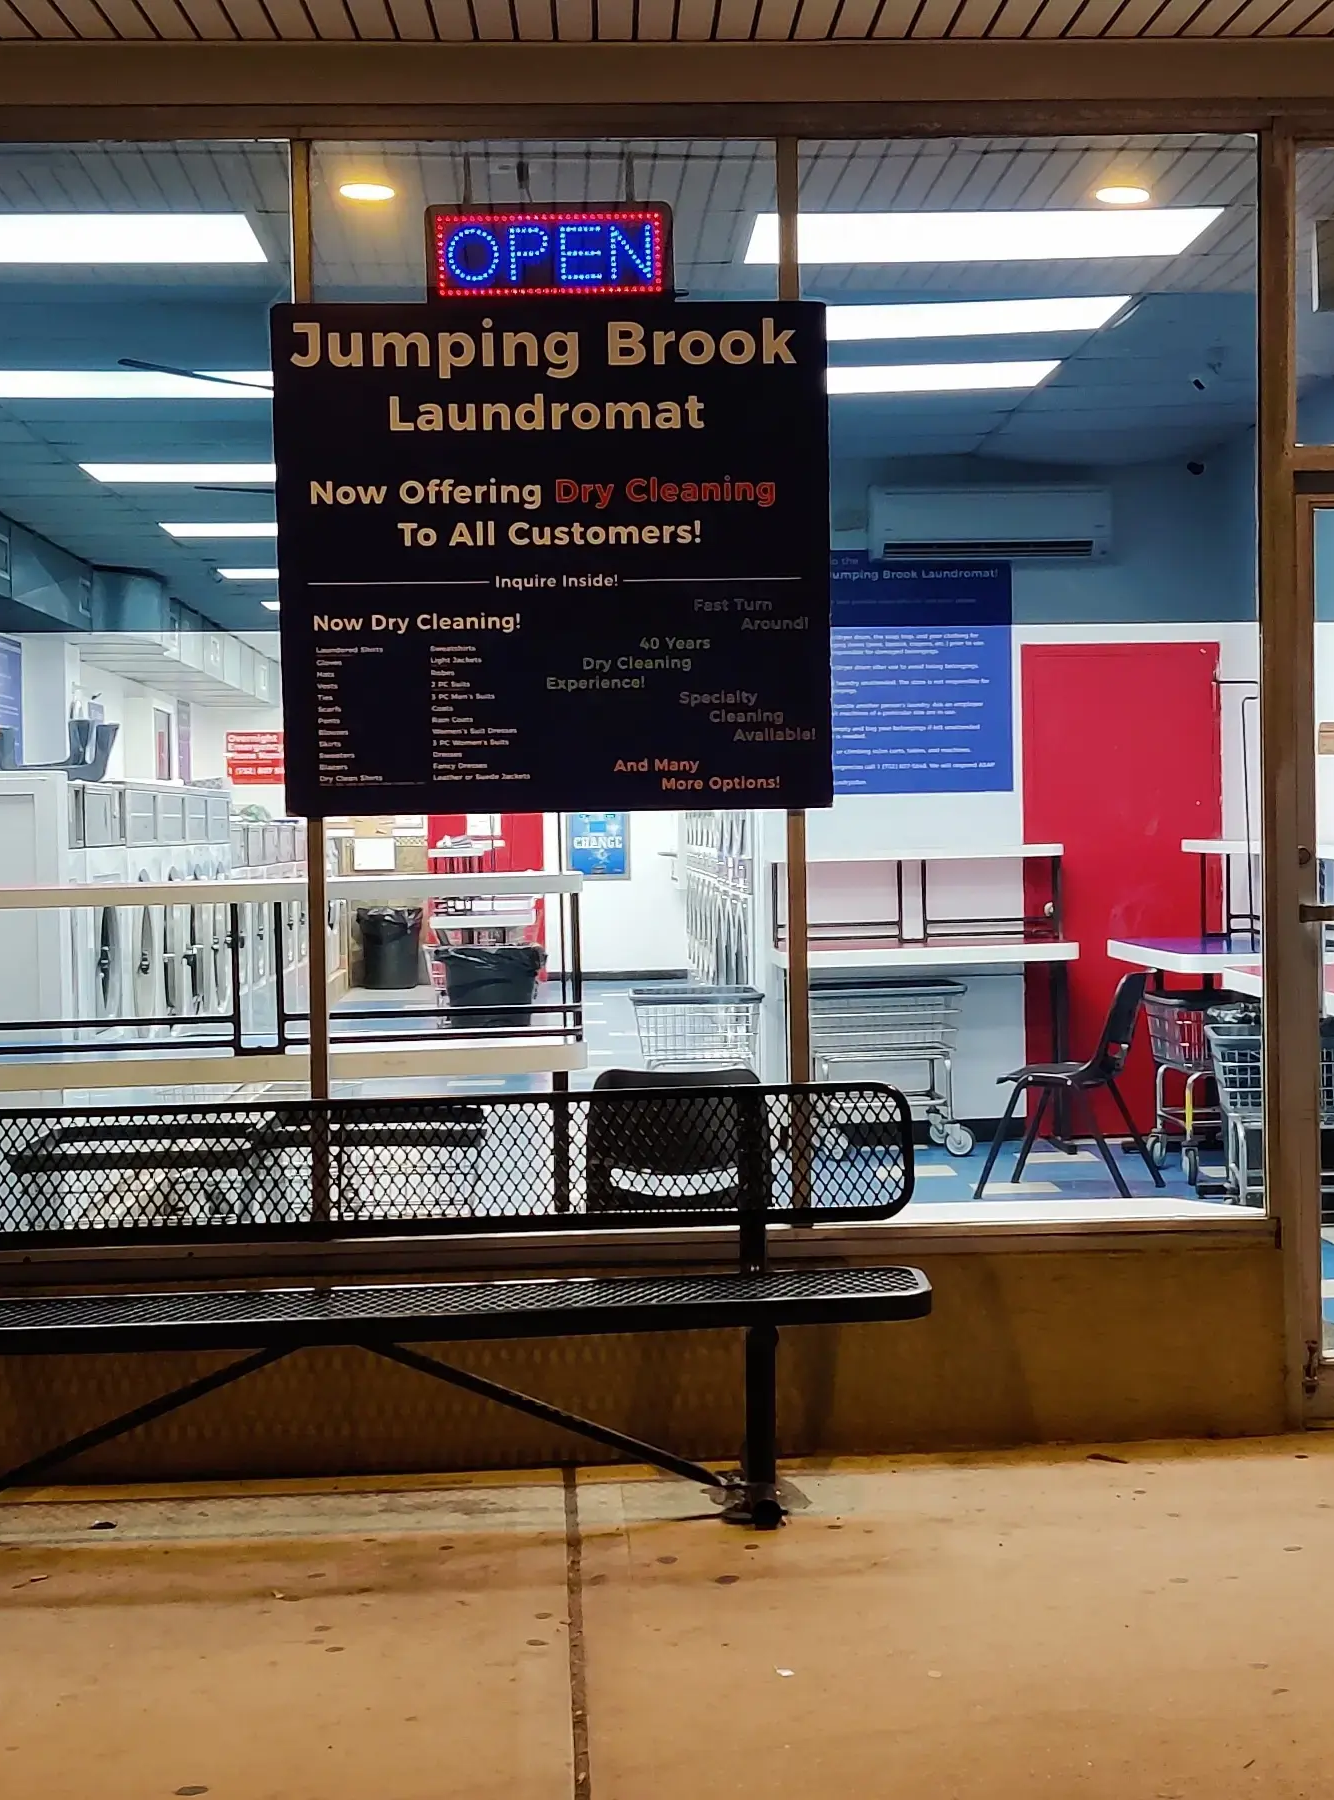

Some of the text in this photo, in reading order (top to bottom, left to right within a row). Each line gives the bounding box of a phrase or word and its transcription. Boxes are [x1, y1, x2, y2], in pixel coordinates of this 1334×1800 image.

[447, 225, 653, 282] OPEN
[290, 317, 797, 379] Jumping Brook
[389, 392, 705, 432] Laundromat
[309, 474, 776, 510] Now Offering Dry Cleaning
[397, 519, 701, 547] To All Customers!
[495, 572, 619, 591] Inquire Inside!
[830, 567, 999, 582] umping Brook Laundromat!
[693, 598, 773, 612] Fast Turn
[313, 612, 521, 634] Now Dry Cleaning!
[741, 616, 809, 631] Around!
[639, 636, 711, 650] 40 Years
[452, 656, 483, 664] Jackets
[582, 655, 692, 673] Dry Cleaning
[546, 676, 646, 692] Experience!
[679, 689, 758, 707] Specialty
[709, 709, 784, 725] Cleaning
[228, 734, 278, 744] Overnight
[733, 726, 816, 742] Available!
[614, 758, 699, 774] And Many
[319, 776, 334, 784] Dry
[662, 775, 781, 792] More Options!
[573, 835, 623, 849] CHANGE
